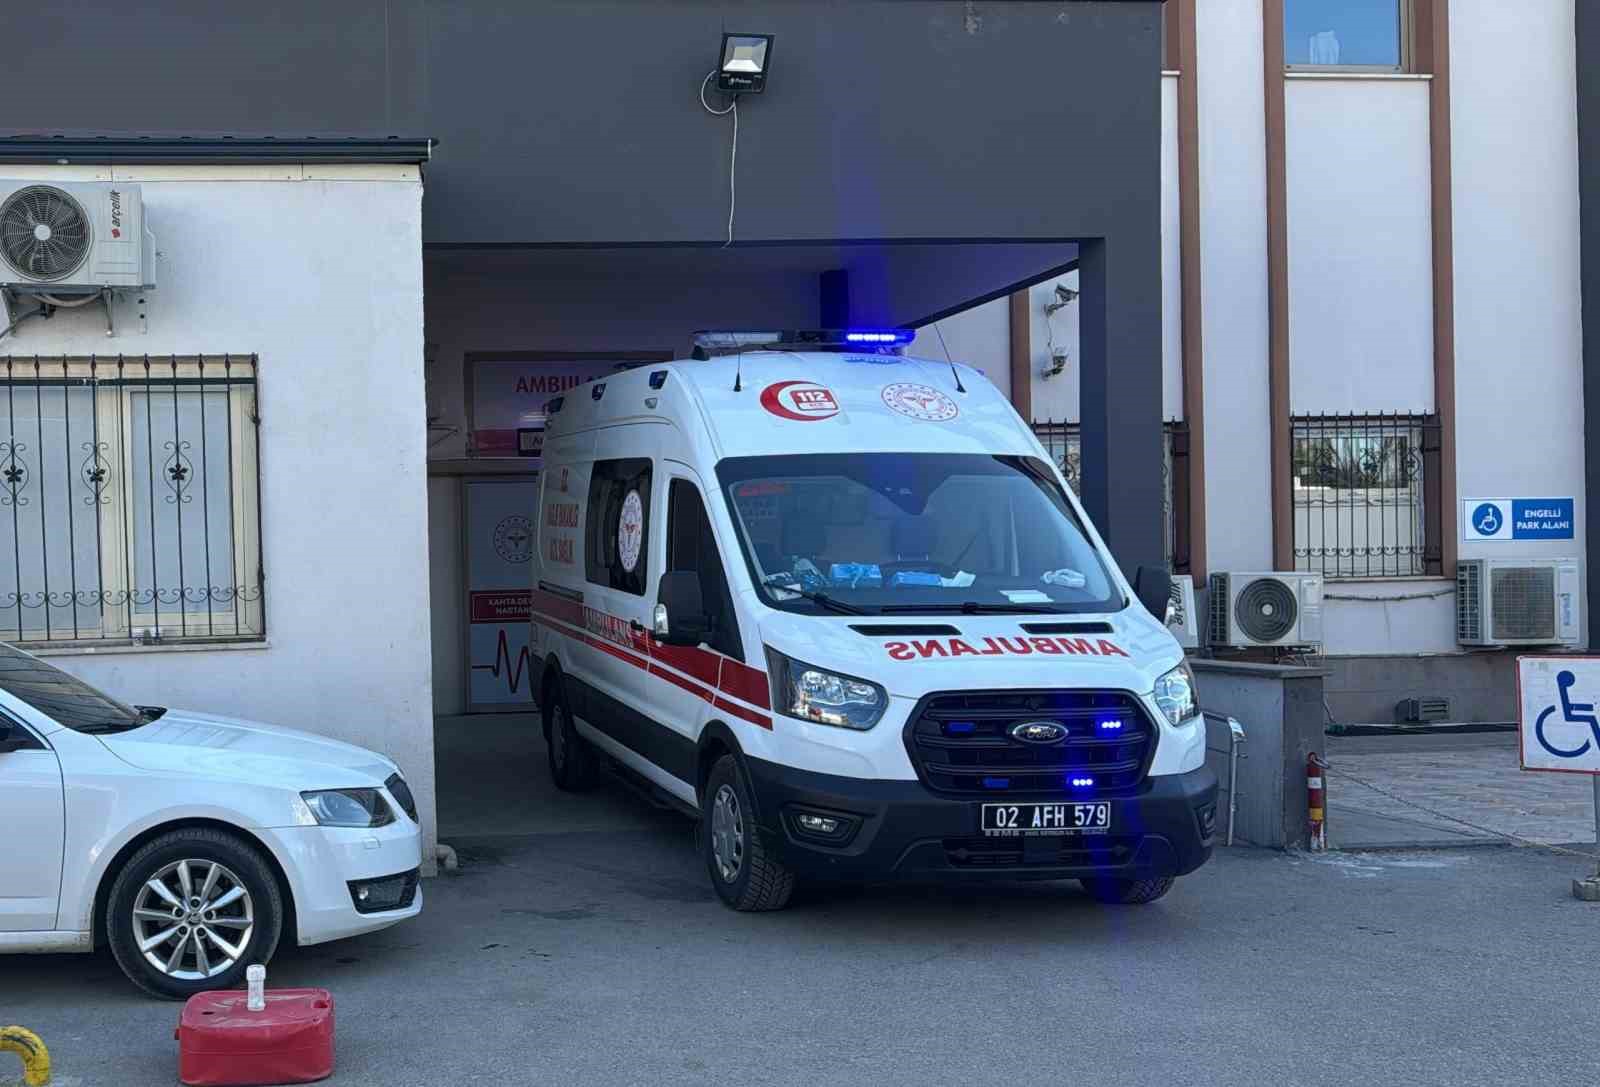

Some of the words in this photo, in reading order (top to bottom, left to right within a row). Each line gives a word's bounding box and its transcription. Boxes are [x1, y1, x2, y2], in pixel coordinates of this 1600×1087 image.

[110, 189, 123, 227] arçelik
[796, 391, 828, 402] 112
[1525, 507, 1561, 518] ENGELLİ
[1517, 521, 1540, 529] PARK
[1542, 521, 1569, 529] ALANI
[996, 806, 1019, 828] 02
[1032, 806, 1065, 828] AFH
[1074, 804, 1107, 826] 579
